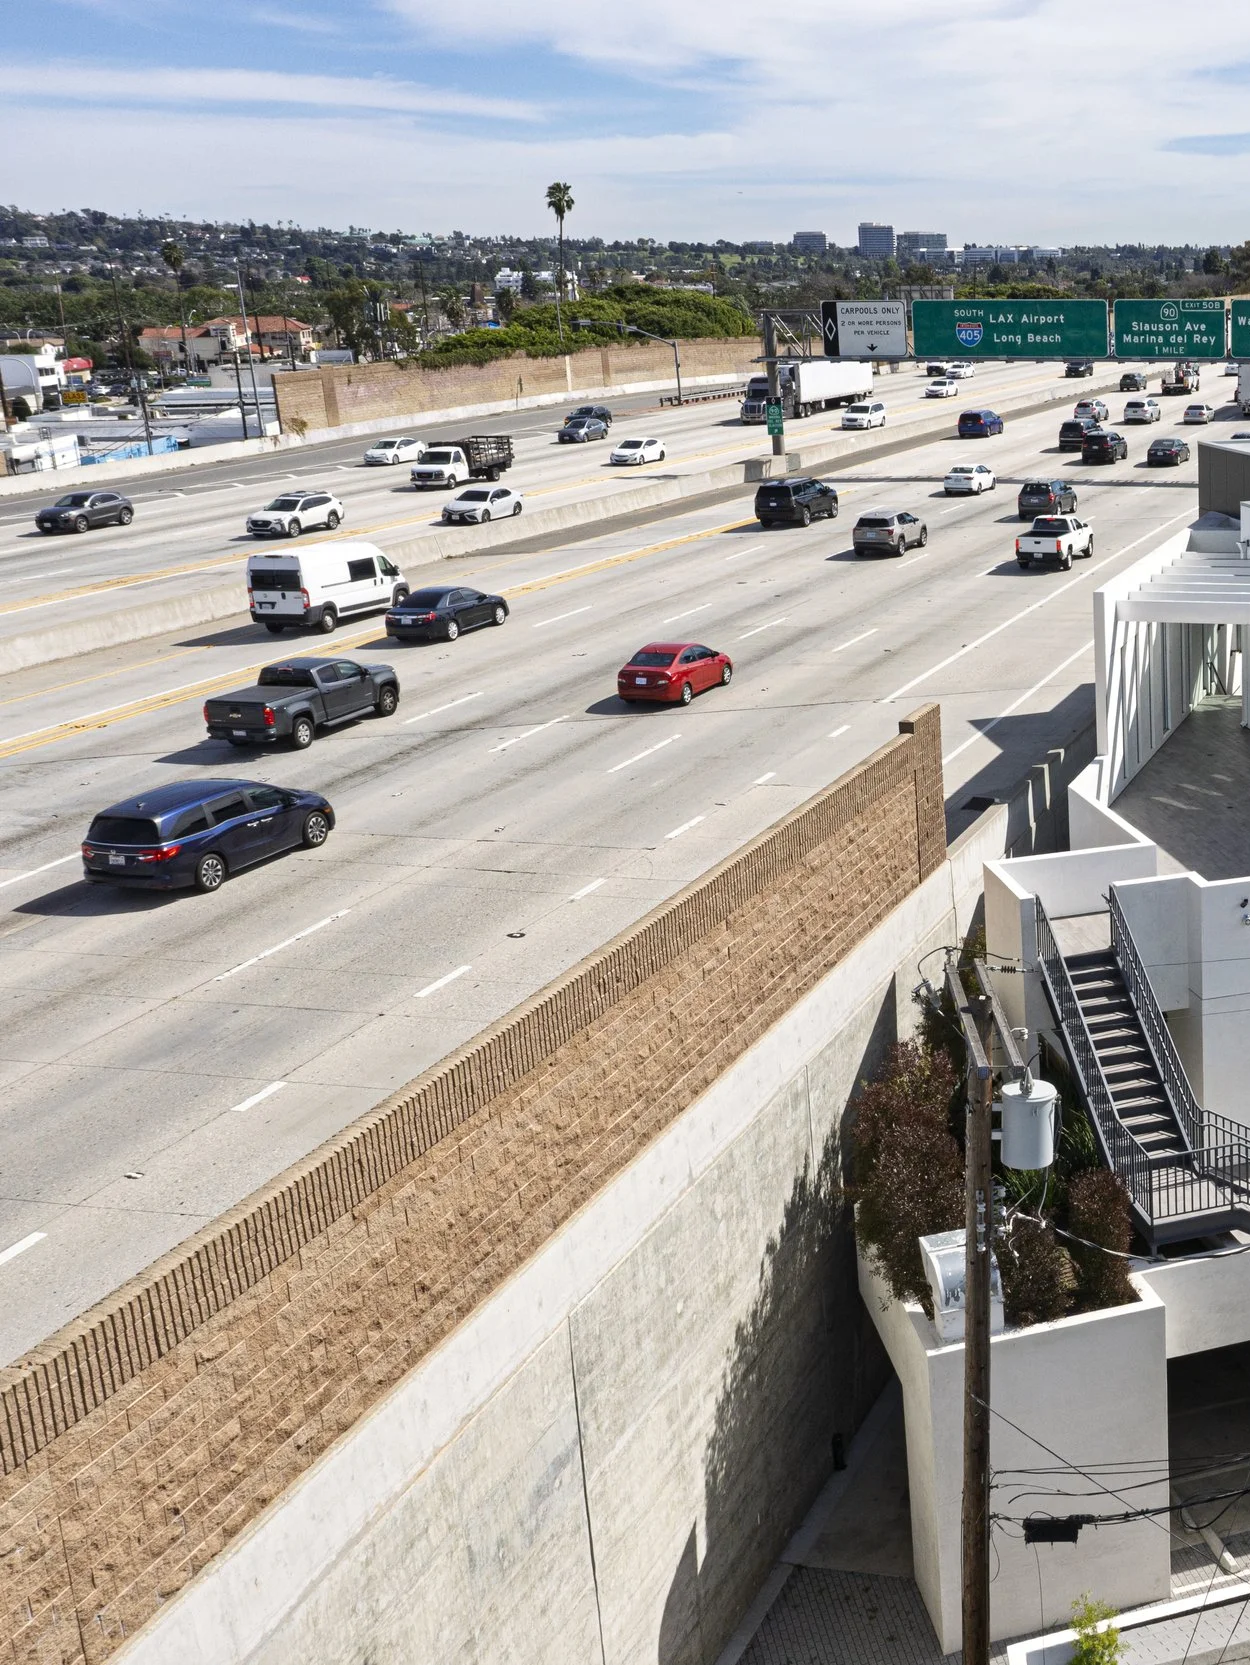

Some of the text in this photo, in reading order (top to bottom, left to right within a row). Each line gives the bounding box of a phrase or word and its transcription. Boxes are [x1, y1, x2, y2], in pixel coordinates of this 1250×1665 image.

[840, 307, 900, 315] CARPOOLS ONLY
[954, 309, 984, 317] SOUTH
[1163, 308, 1176, 317] 90
[989, 314, 1065, 325] LAX Airport
[1131, 321, 1207, 331] Slauson Ave
[959, 330, 980, 341] 405
[993, 333, 1061, 345] Long Beach
[1123, 334, 1216, 346] Marina del Rey
[1154, 346, 1185, 354] 1 MILE
